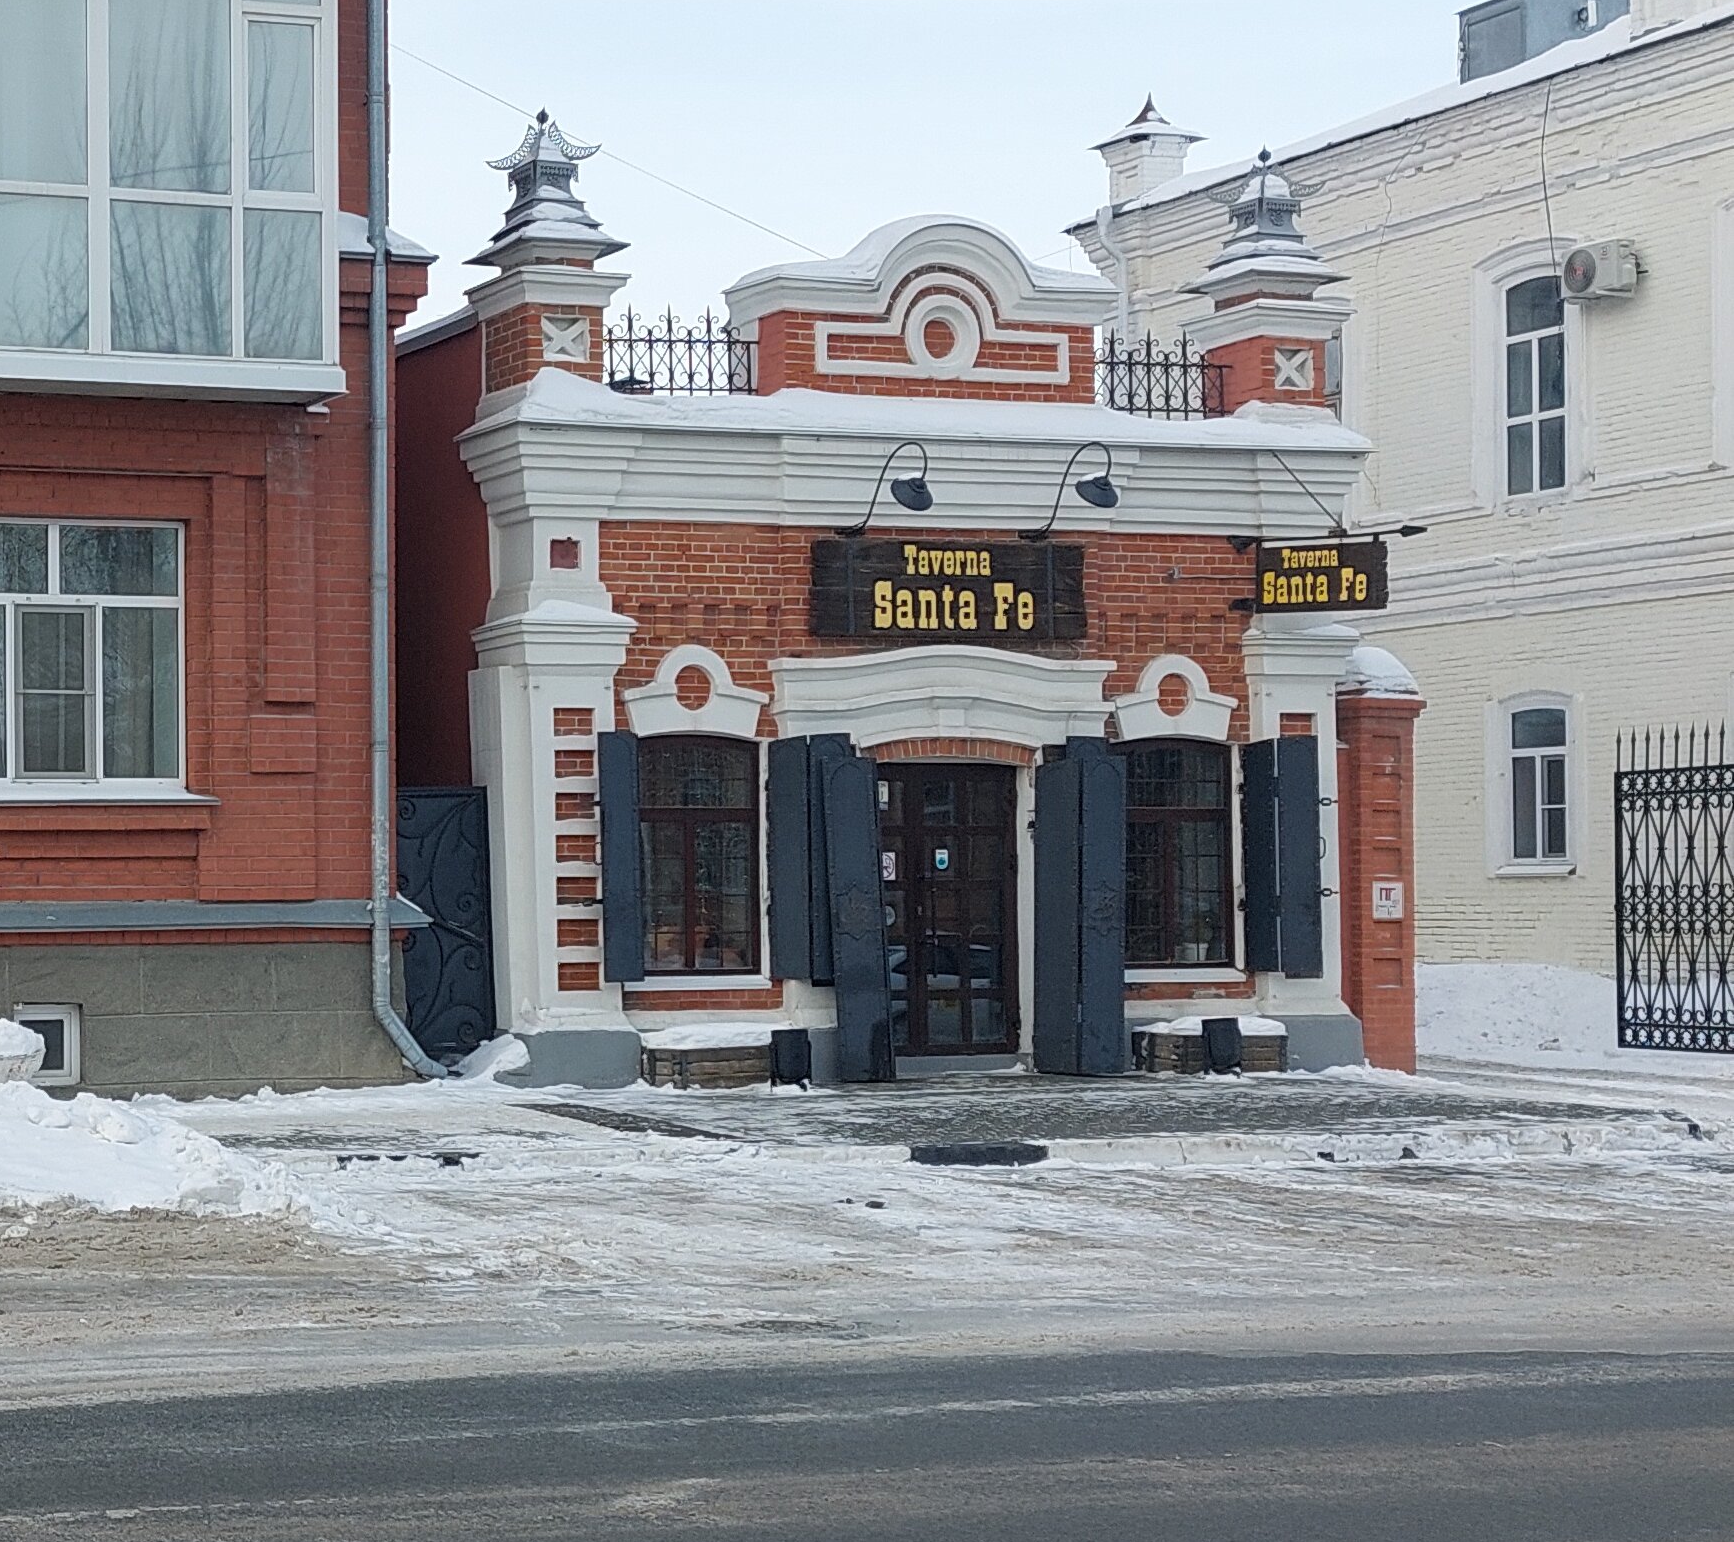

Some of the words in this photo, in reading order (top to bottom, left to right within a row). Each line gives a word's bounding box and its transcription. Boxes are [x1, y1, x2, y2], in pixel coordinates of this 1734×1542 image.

[903, 544, 992, 577] Taverna
[1281, 548, 1339, 569] Taverna
[1262, 571, 1329, 605] Santa
[1339, 567, 1368, 601] Fe
[873, 580, 978, 630] Santa
[993, 582, 1035, 631] Fe
